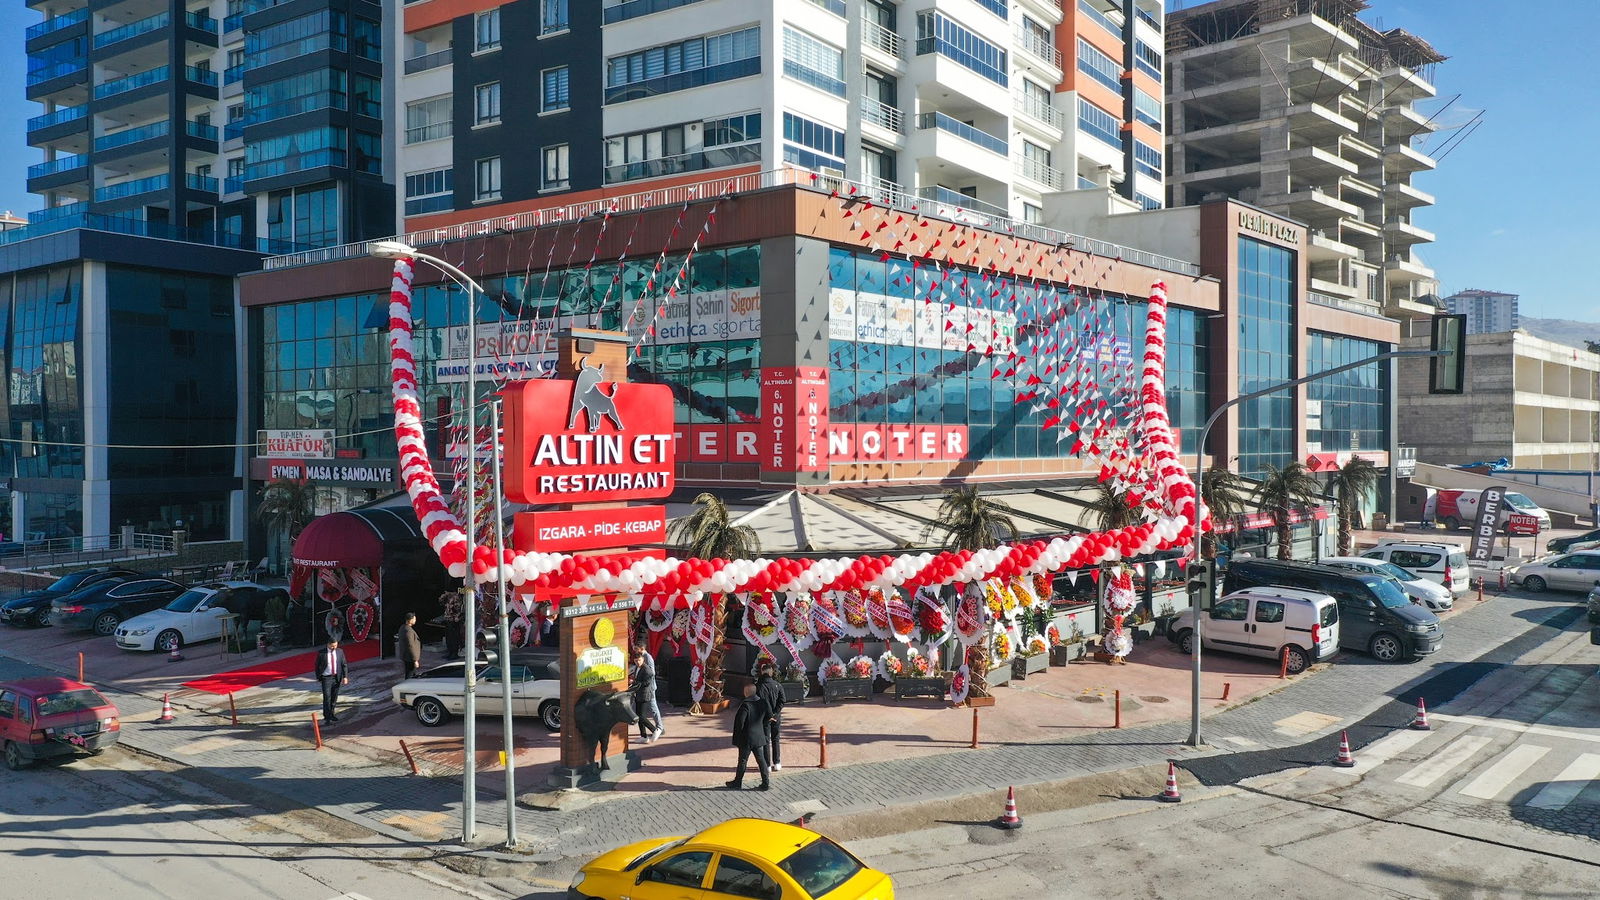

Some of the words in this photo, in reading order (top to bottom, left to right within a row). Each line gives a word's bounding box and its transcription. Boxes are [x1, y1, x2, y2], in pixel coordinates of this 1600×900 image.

[1271, 222, 1298, 244] PLAZA
[660, 321, 707, 339] ethica
[774, 390, 782, 399] 6.
[773, 402, 784, 468] NOTER
[808, 402, 818, 467] NOTER
[829, 431, 963, 456] NOTER
[534, 434, 624, 466] ALTIN
[634, 434, 672, 463] ET
[272, 465, 300, 479] EYMEN
[306, 466, 332, 480] MASA
[333, 466, 340, 480] &
[341, 467, 391, 482] SANDALYE
[540, 471, 671, 493] RESTAURANT
[594, 521, 621, 536] PİDE
[1475, 490, 1500, 559] BERBER
[1510, 516, 1537, 526] NOTER
